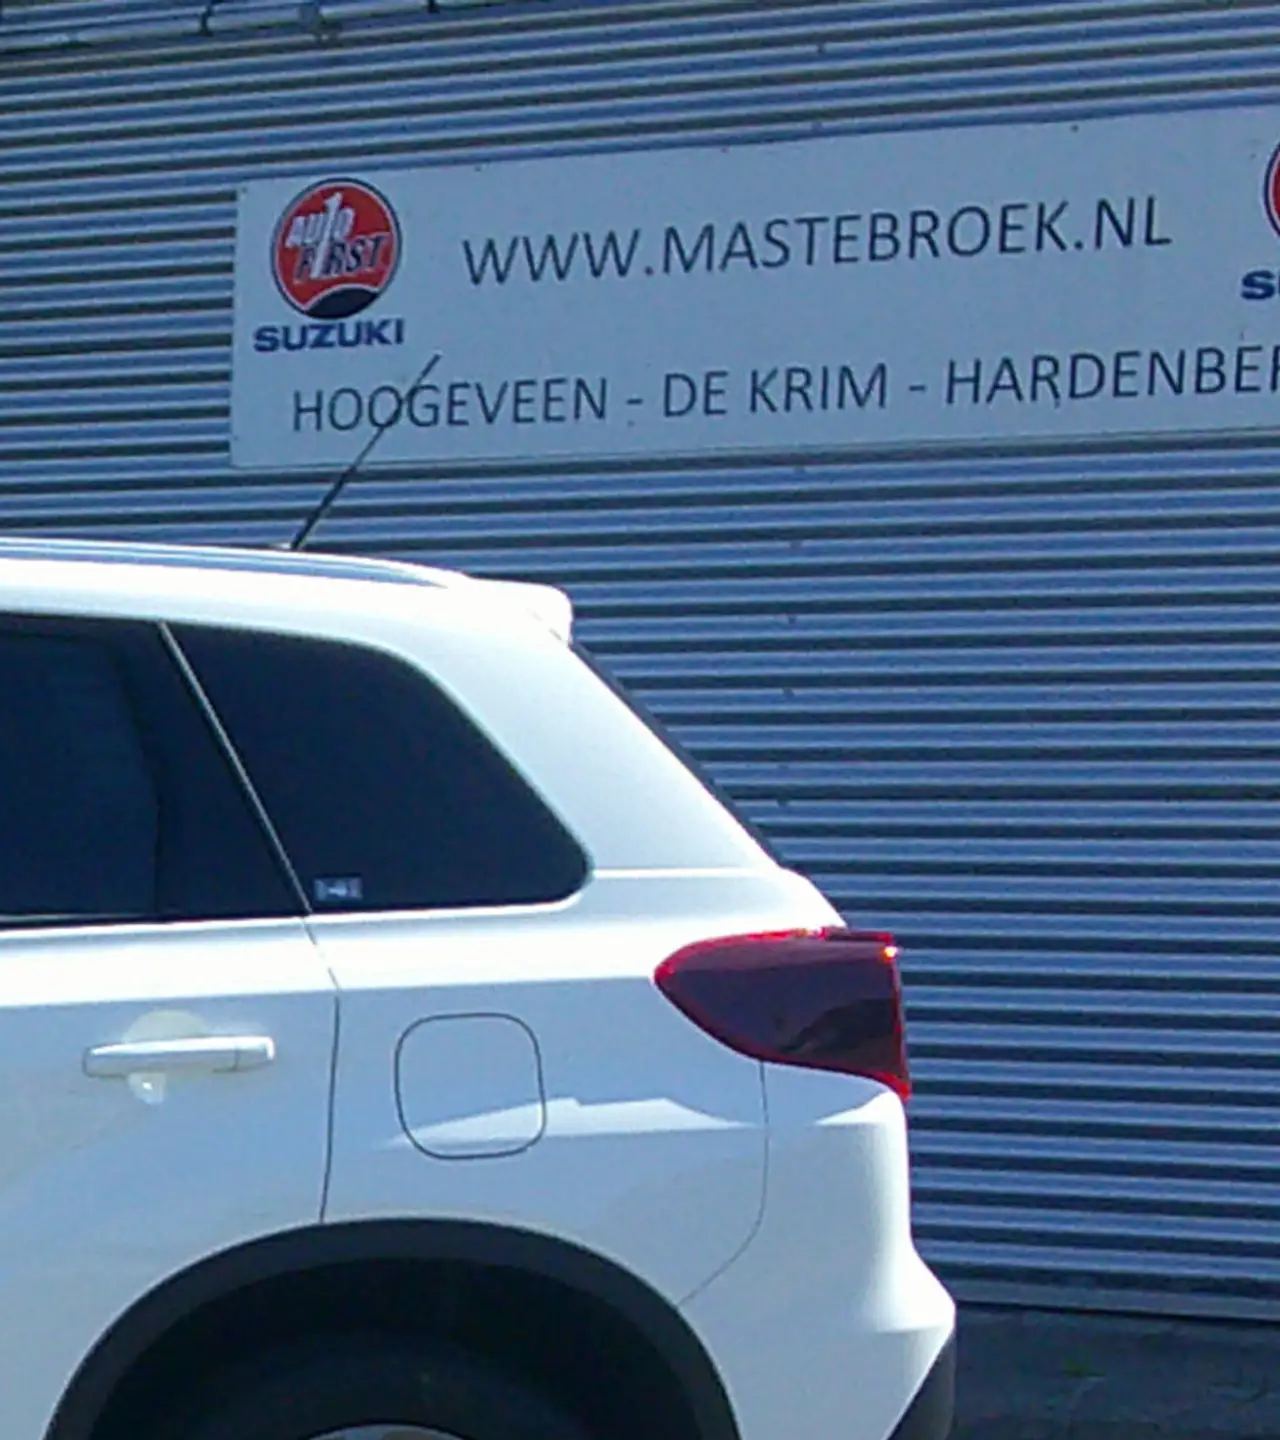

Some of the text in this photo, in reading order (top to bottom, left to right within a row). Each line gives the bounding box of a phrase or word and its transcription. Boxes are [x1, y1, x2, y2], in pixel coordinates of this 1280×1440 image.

[462, 195, 1173, 287] WWW.MASTEBROEK.NL
[253, 317, 406, 353] SUZUKI
[292, 376, 608, 432] HOOGEVEEN
[662, 370, 729, 418] DE
[748, 361, 888, 415] KRIM
